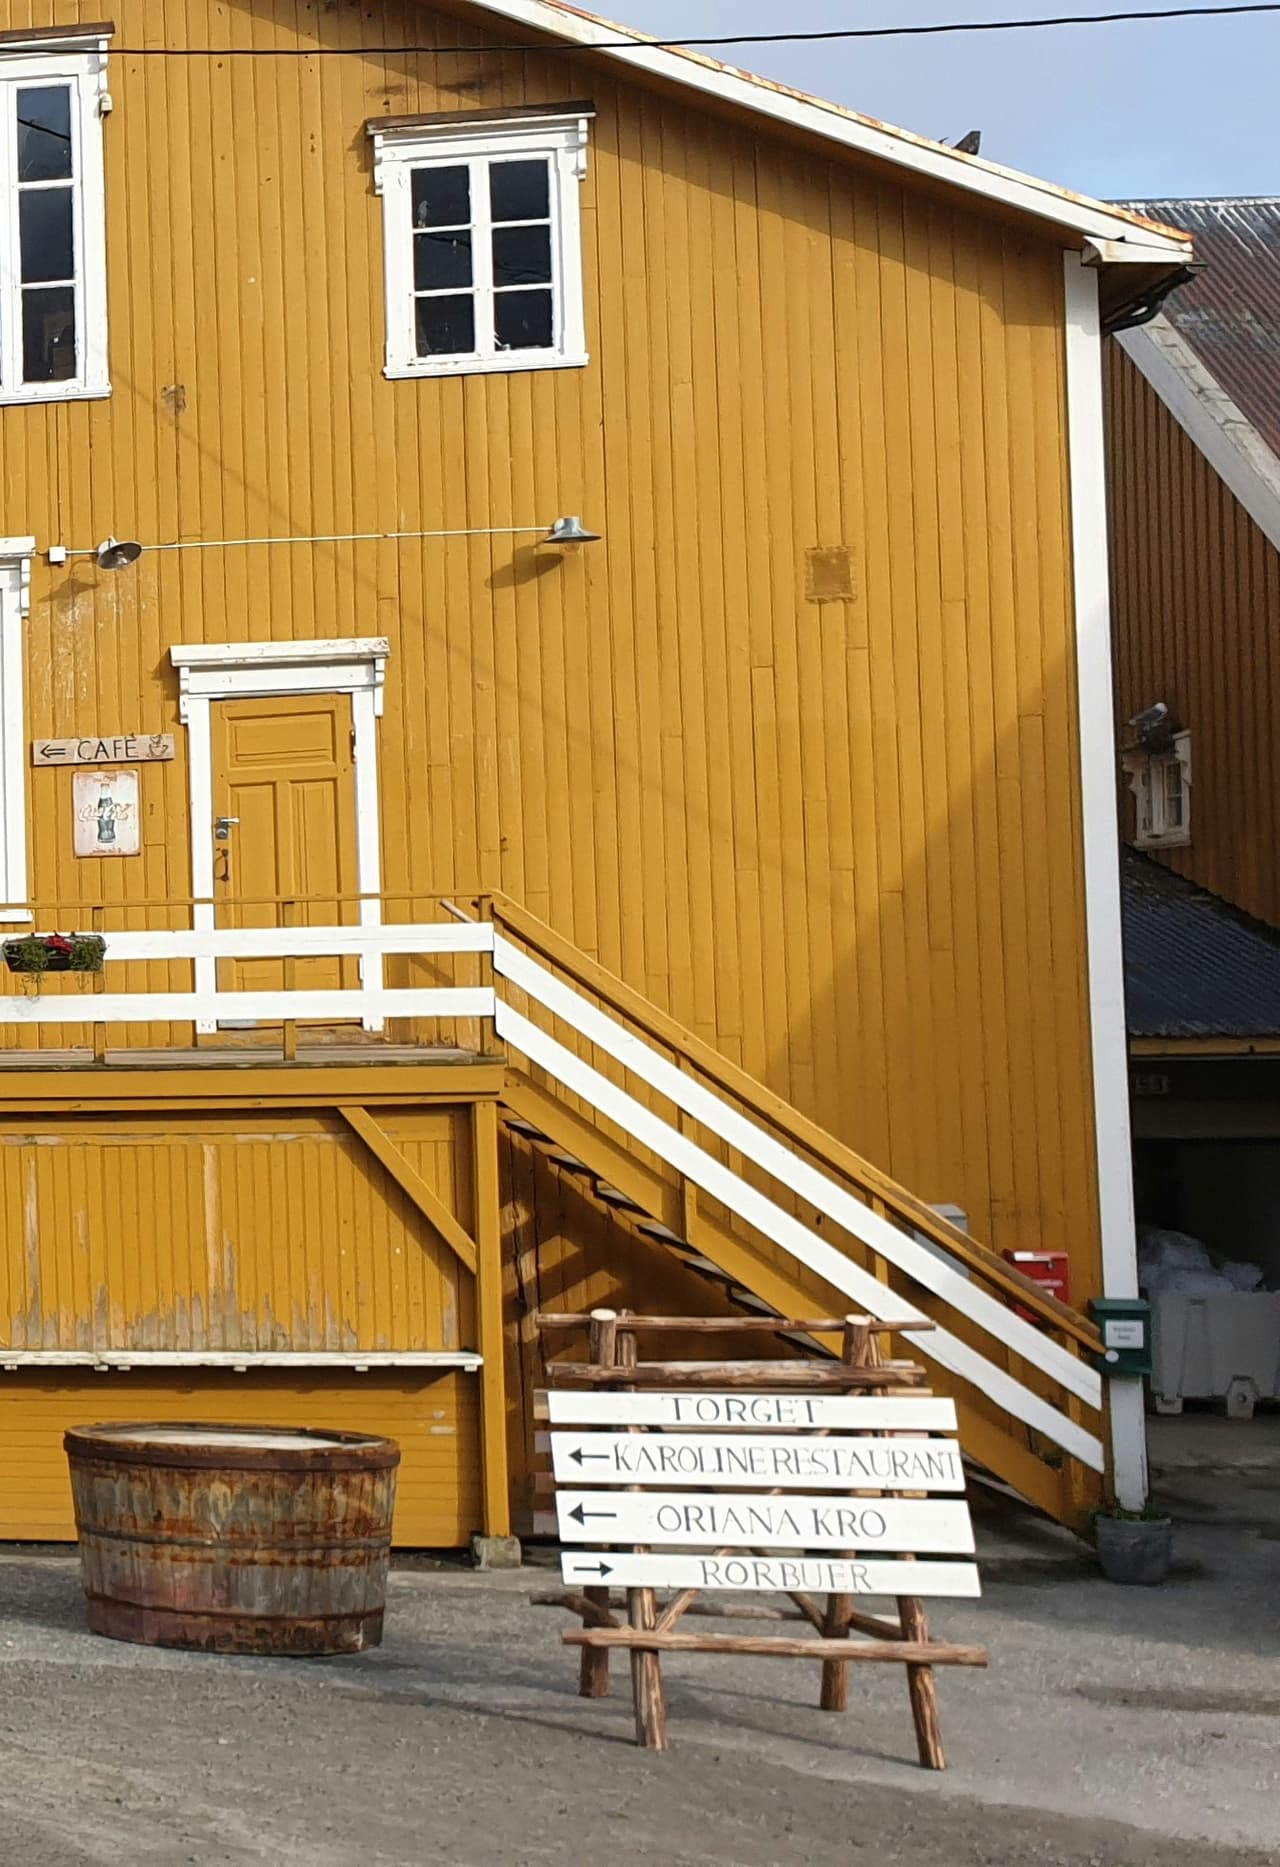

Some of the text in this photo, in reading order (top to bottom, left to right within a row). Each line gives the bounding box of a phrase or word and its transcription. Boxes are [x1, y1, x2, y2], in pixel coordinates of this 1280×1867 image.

[661, 1397, 824, 1424] TORGET
[656, 1504, 887, 1538] ORIANA KRO
[700, 1560, 873, 1591] RORBUER
